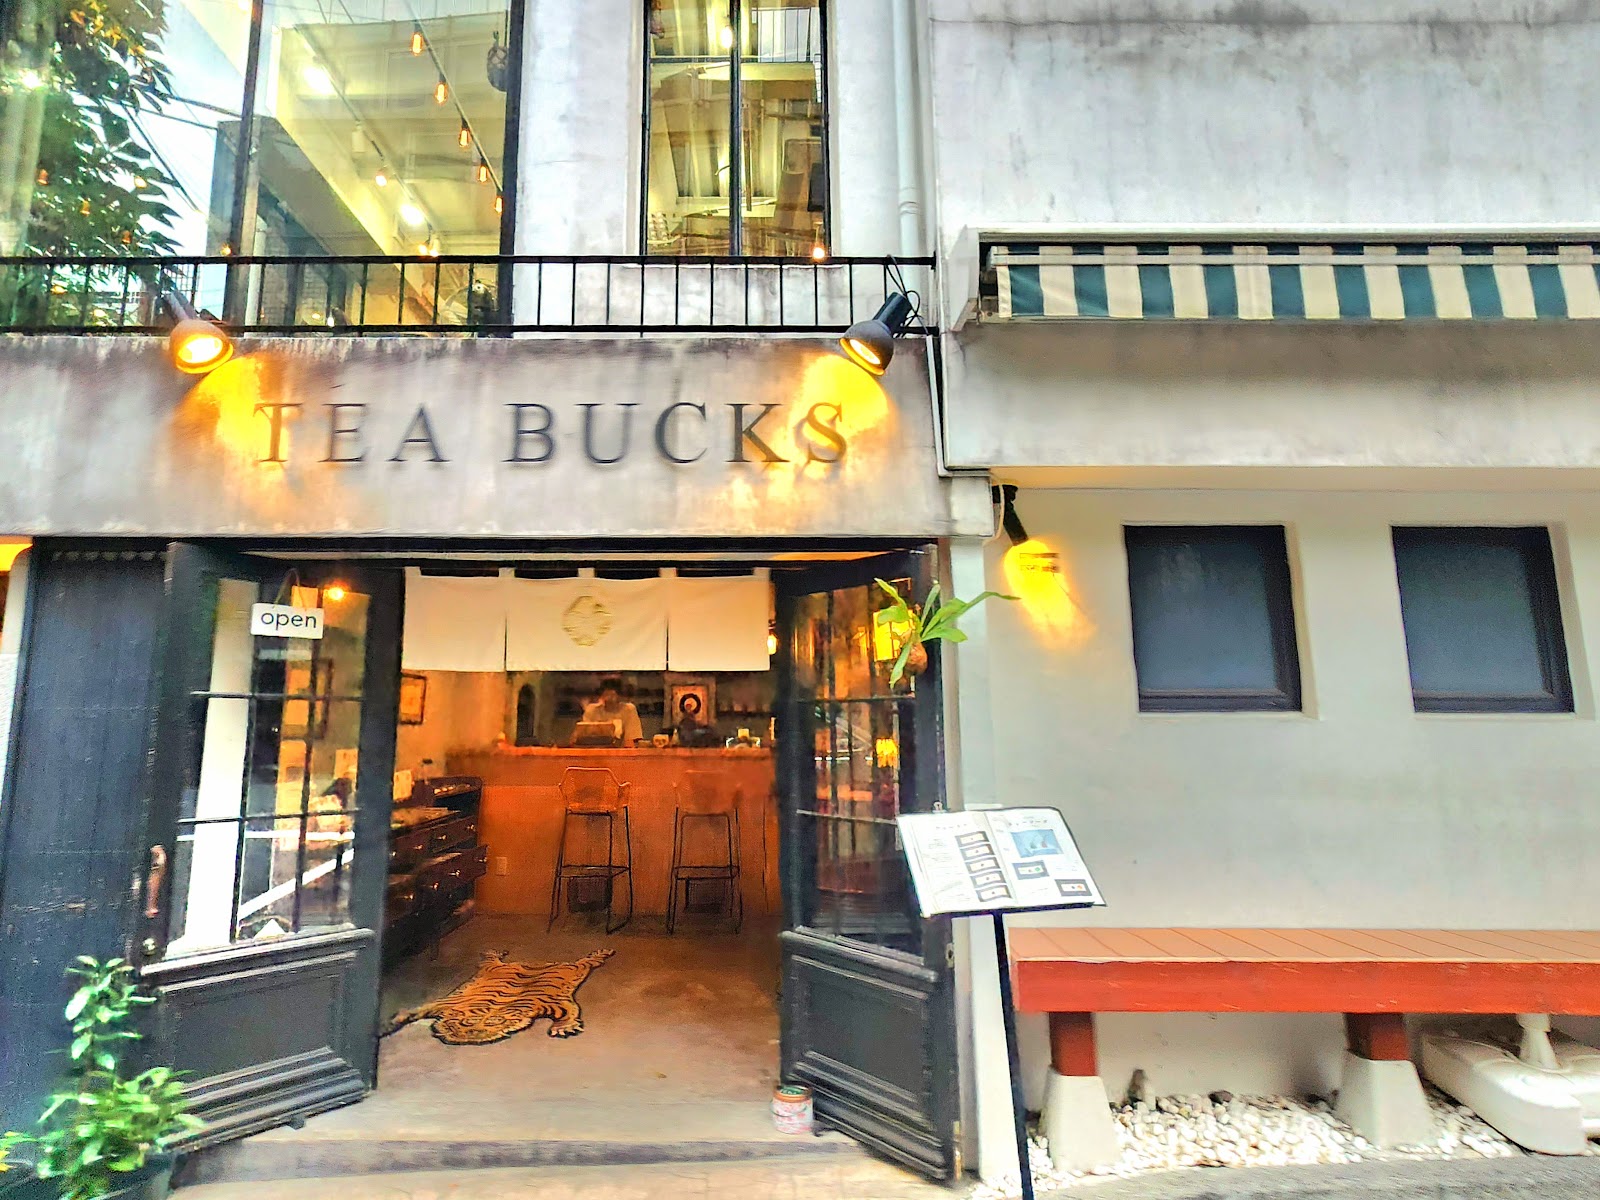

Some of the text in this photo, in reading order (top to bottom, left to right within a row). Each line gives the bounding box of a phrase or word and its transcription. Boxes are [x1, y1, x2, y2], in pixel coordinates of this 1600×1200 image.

[253, 402, 846, 464] TEA BUCKS
[261, 612, 317, 631] open
